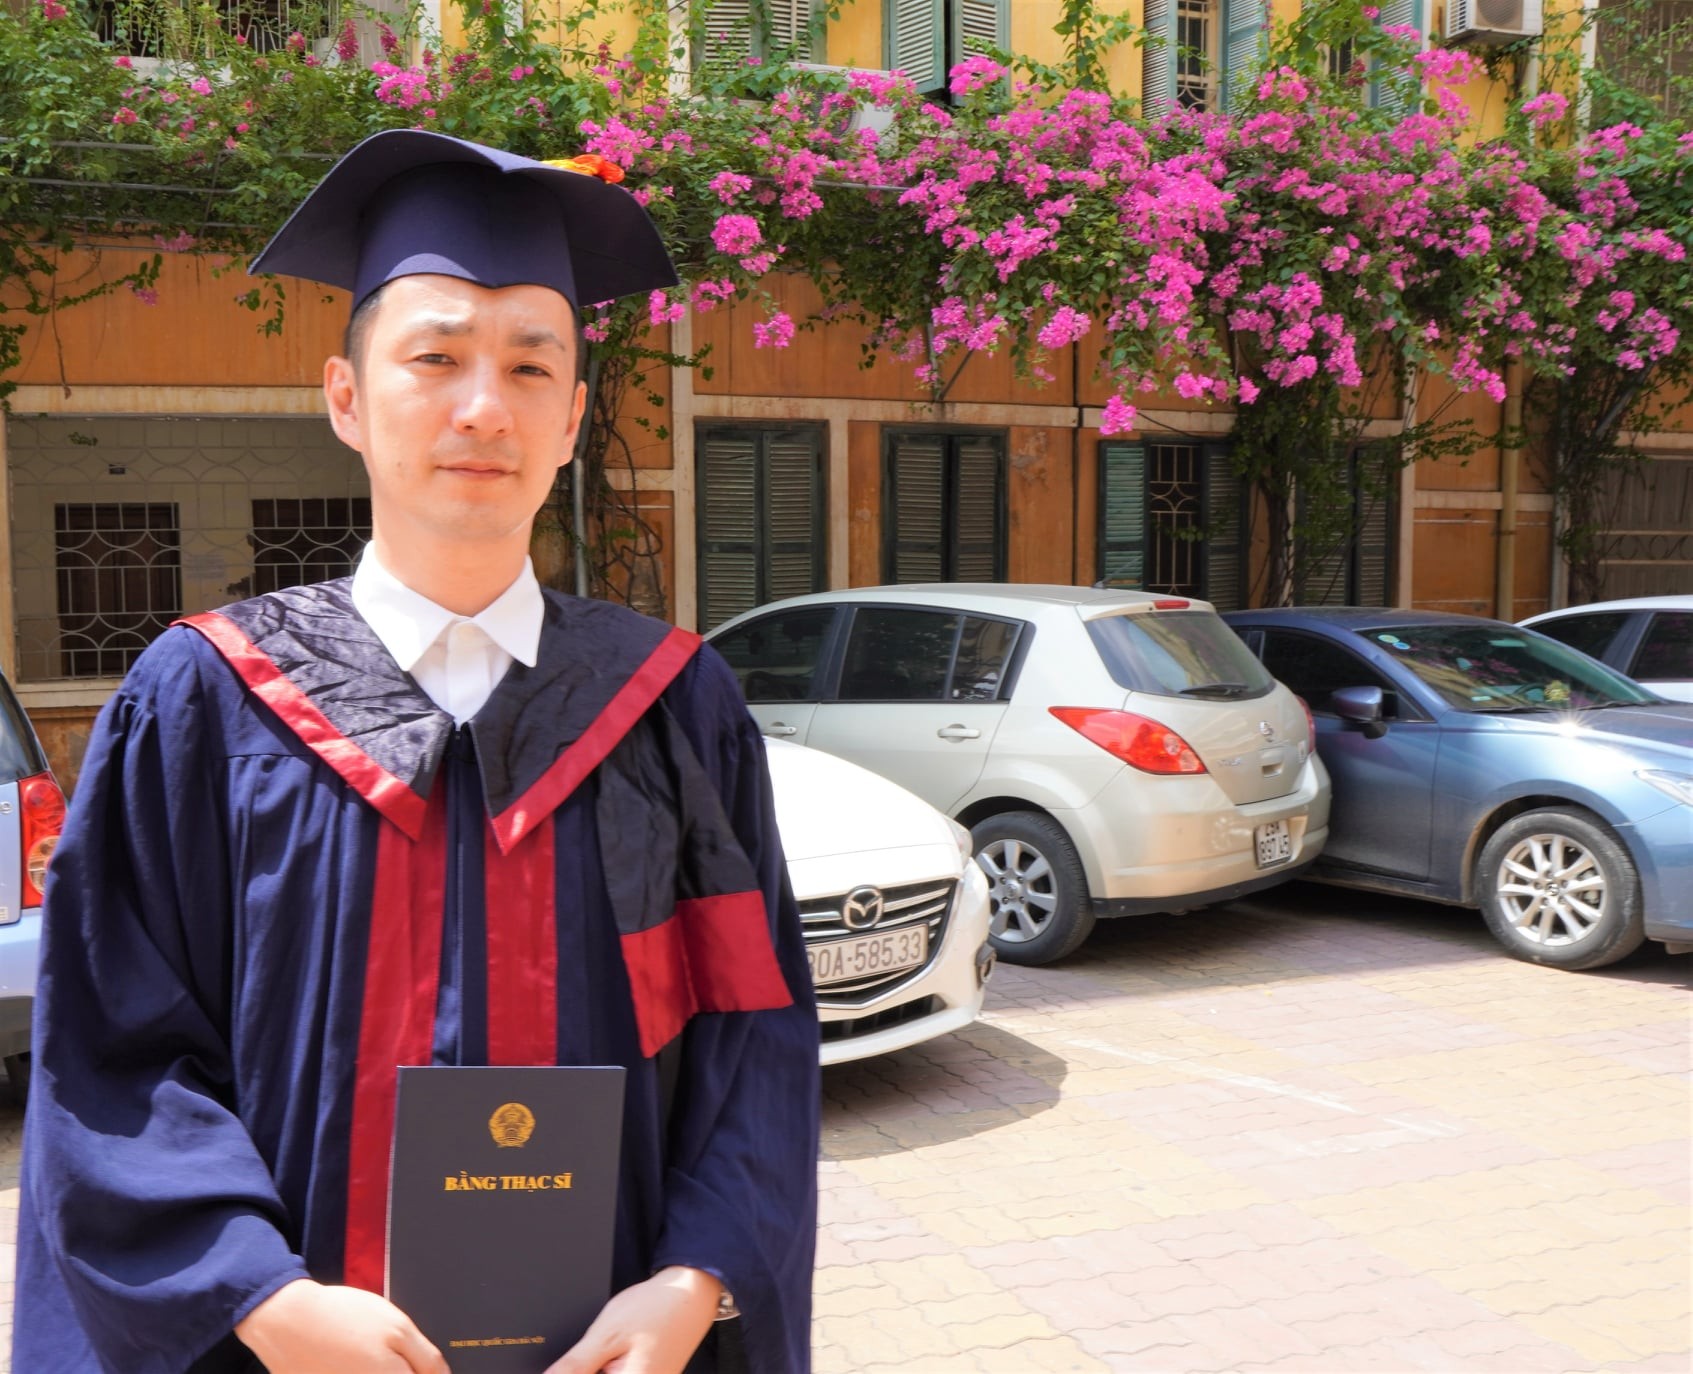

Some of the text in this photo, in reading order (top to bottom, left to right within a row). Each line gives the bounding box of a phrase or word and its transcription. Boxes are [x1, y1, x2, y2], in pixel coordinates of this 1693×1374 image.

[444, 1170, 573, 1192] BẰNG THẠC SĨ
